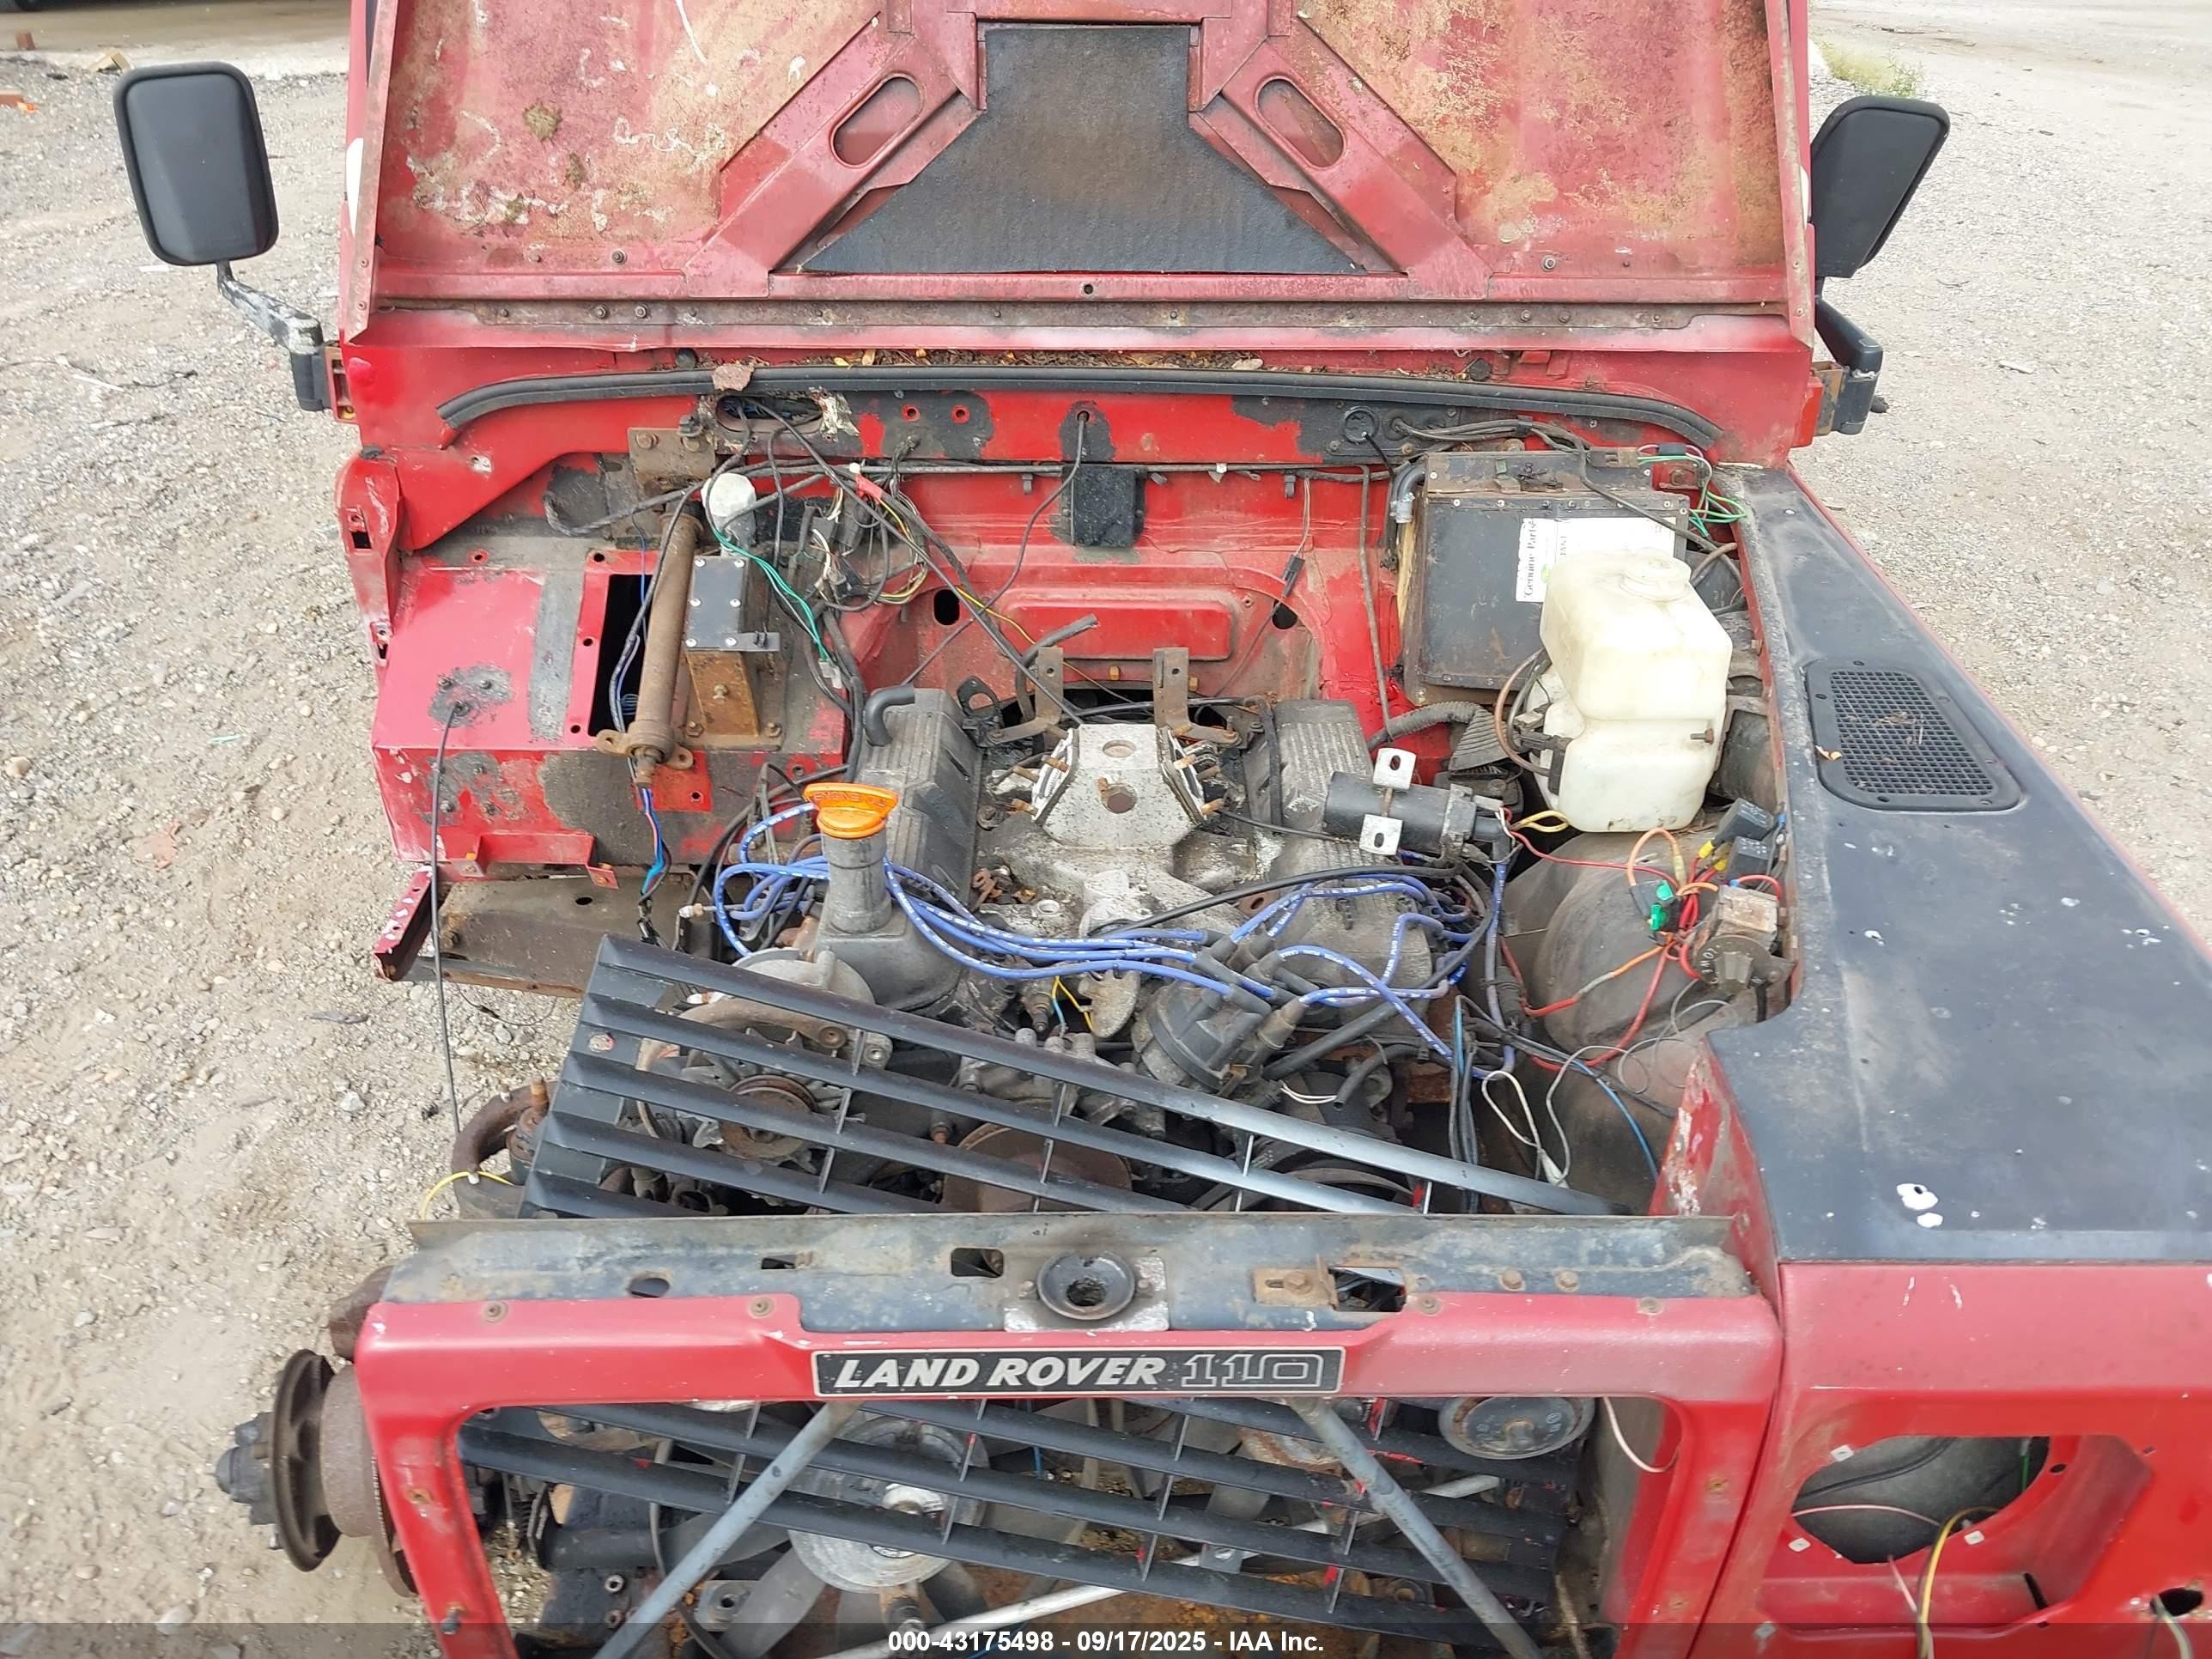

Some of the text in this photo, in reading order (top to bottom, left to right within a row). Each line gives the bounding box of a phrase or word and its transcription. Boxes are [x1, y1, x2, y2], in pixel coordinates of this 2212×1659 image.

[834, 1353, 1325, 1388] LAND ROVER 110
